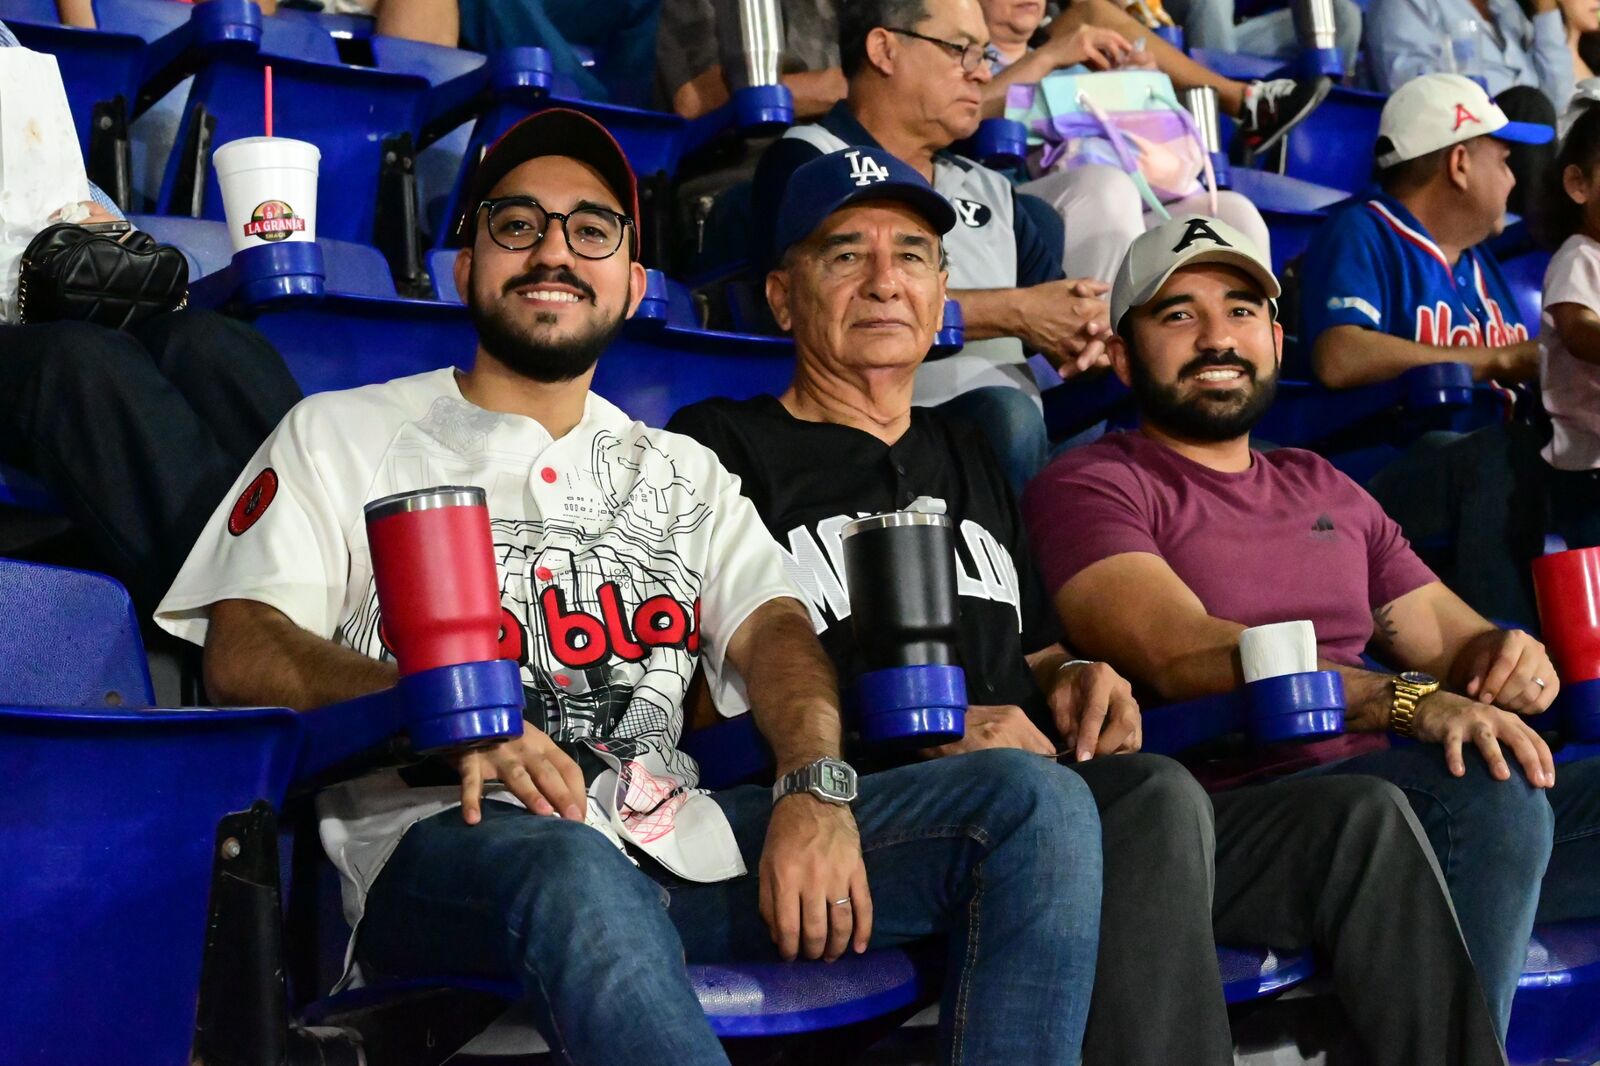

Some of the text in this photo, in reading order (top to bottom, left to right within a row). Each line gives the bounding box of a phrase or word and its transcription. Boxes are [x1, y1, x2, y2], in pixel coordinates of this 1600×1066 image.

[1452, 103, 1481, 131] A
[845, 150, 889, 186] LA
[955, 199, 982, 226] Y
[248, 223, 261, 235] LA
[1172, 218, 1233, 253] A
